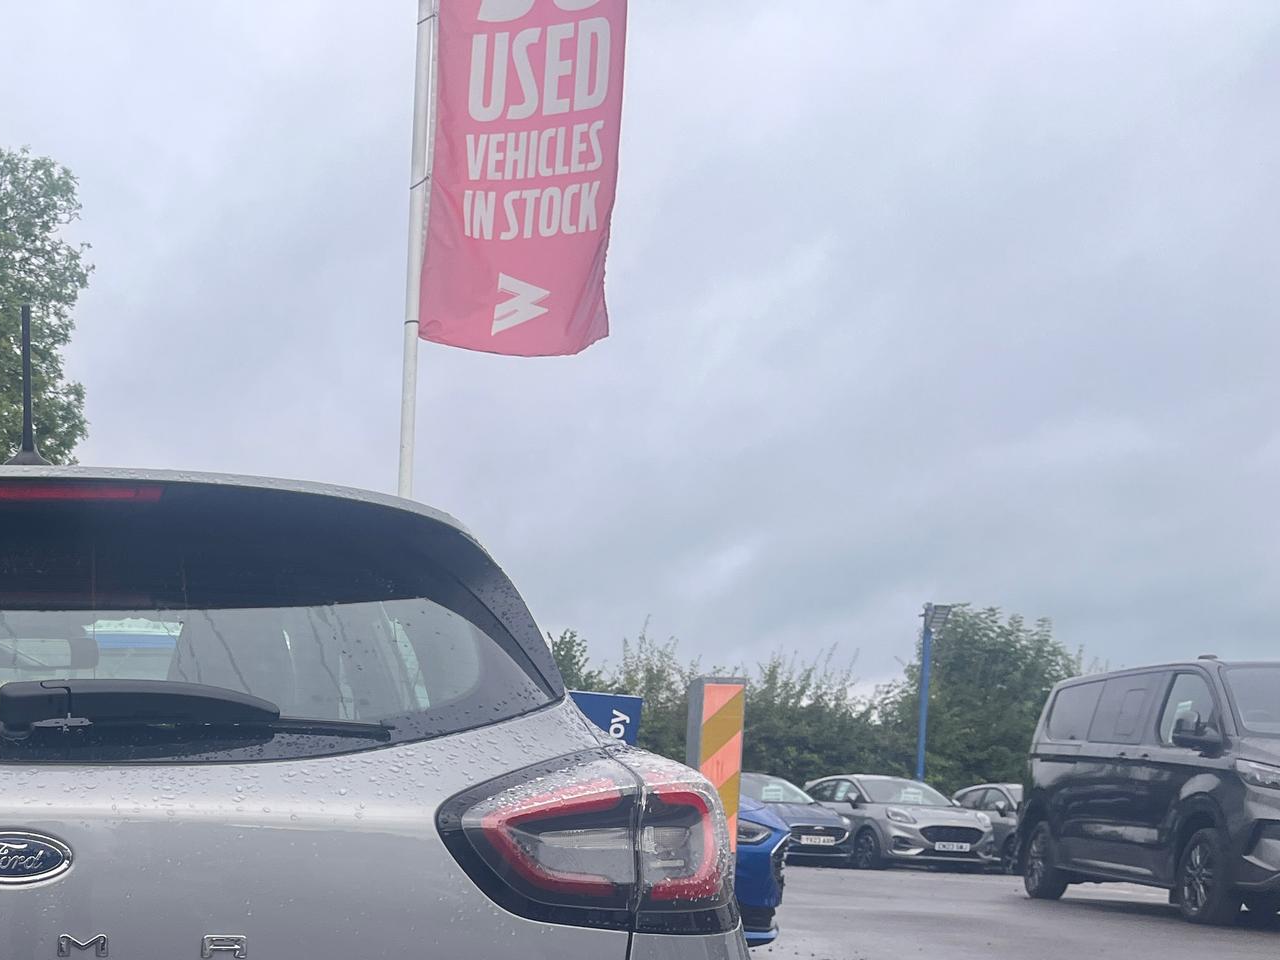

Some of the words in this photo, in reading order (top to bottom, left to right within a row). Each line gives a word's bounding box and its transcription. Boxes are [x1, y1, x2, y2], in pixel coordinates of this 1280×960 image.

[468, 17, 611, 122] USED
[466, 120, 604, 181] VEHICLES
[463, 190, 496, 241] IN
[500, 181, 601, 241] STOCK
